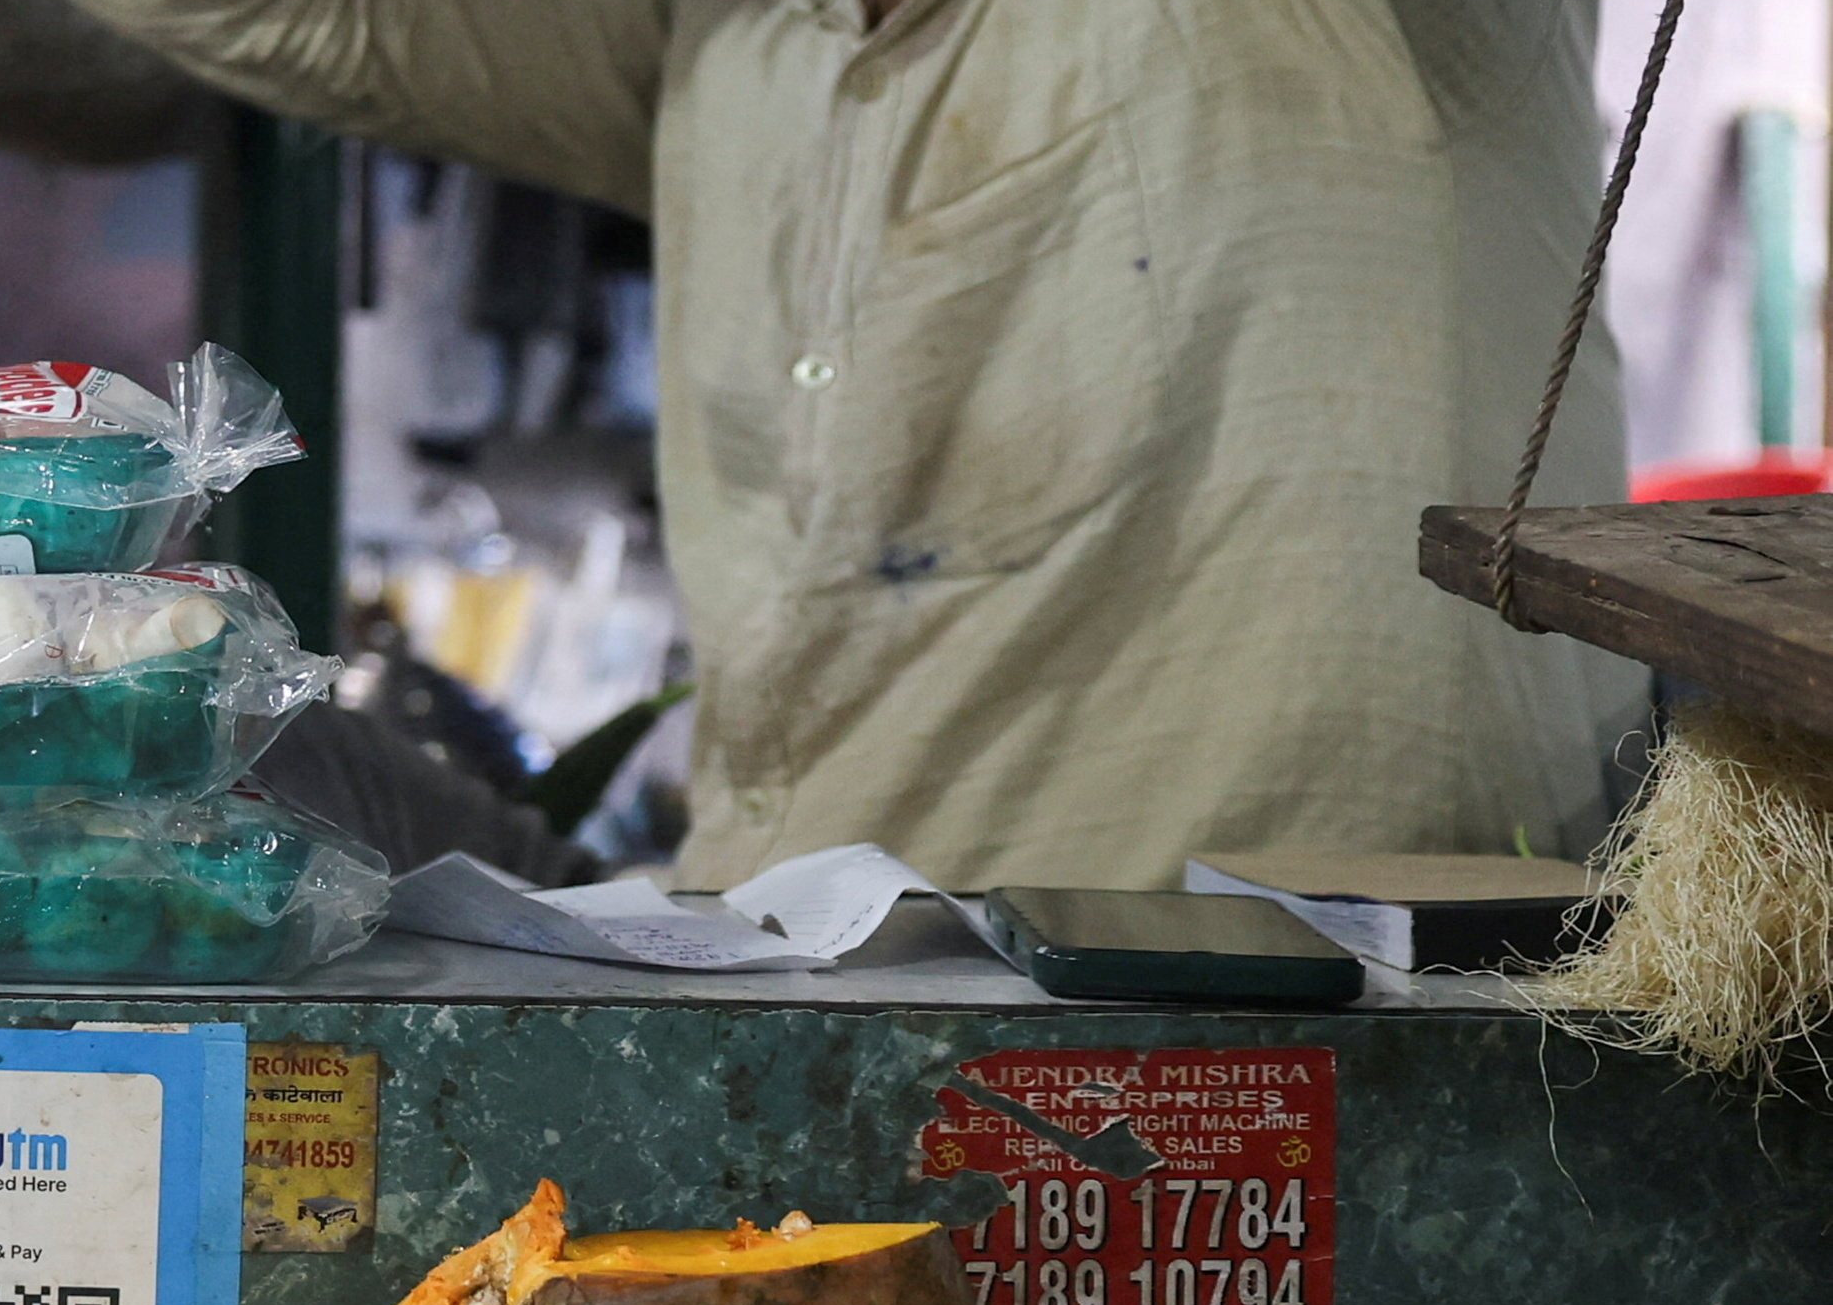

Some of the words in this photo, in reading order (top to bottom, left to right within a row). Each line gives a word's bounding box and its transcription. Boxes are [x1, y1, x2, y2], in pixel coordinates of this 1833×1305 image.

[965, 1065, 1144, 1089] AJENDRA
[1160, 1062, 1312, 1087] MISHRA
[279, 1113, 331, 1124] SERVICE
[1200, 1112, 1311, 1132] MACHINE
[1165, 1136, 1243, 1154] SALES
[22, 1176, 67, 1192] Here
[1130, 1178, 1306, 1251] 17784
[10, 1244, 43, 1263] Pay
